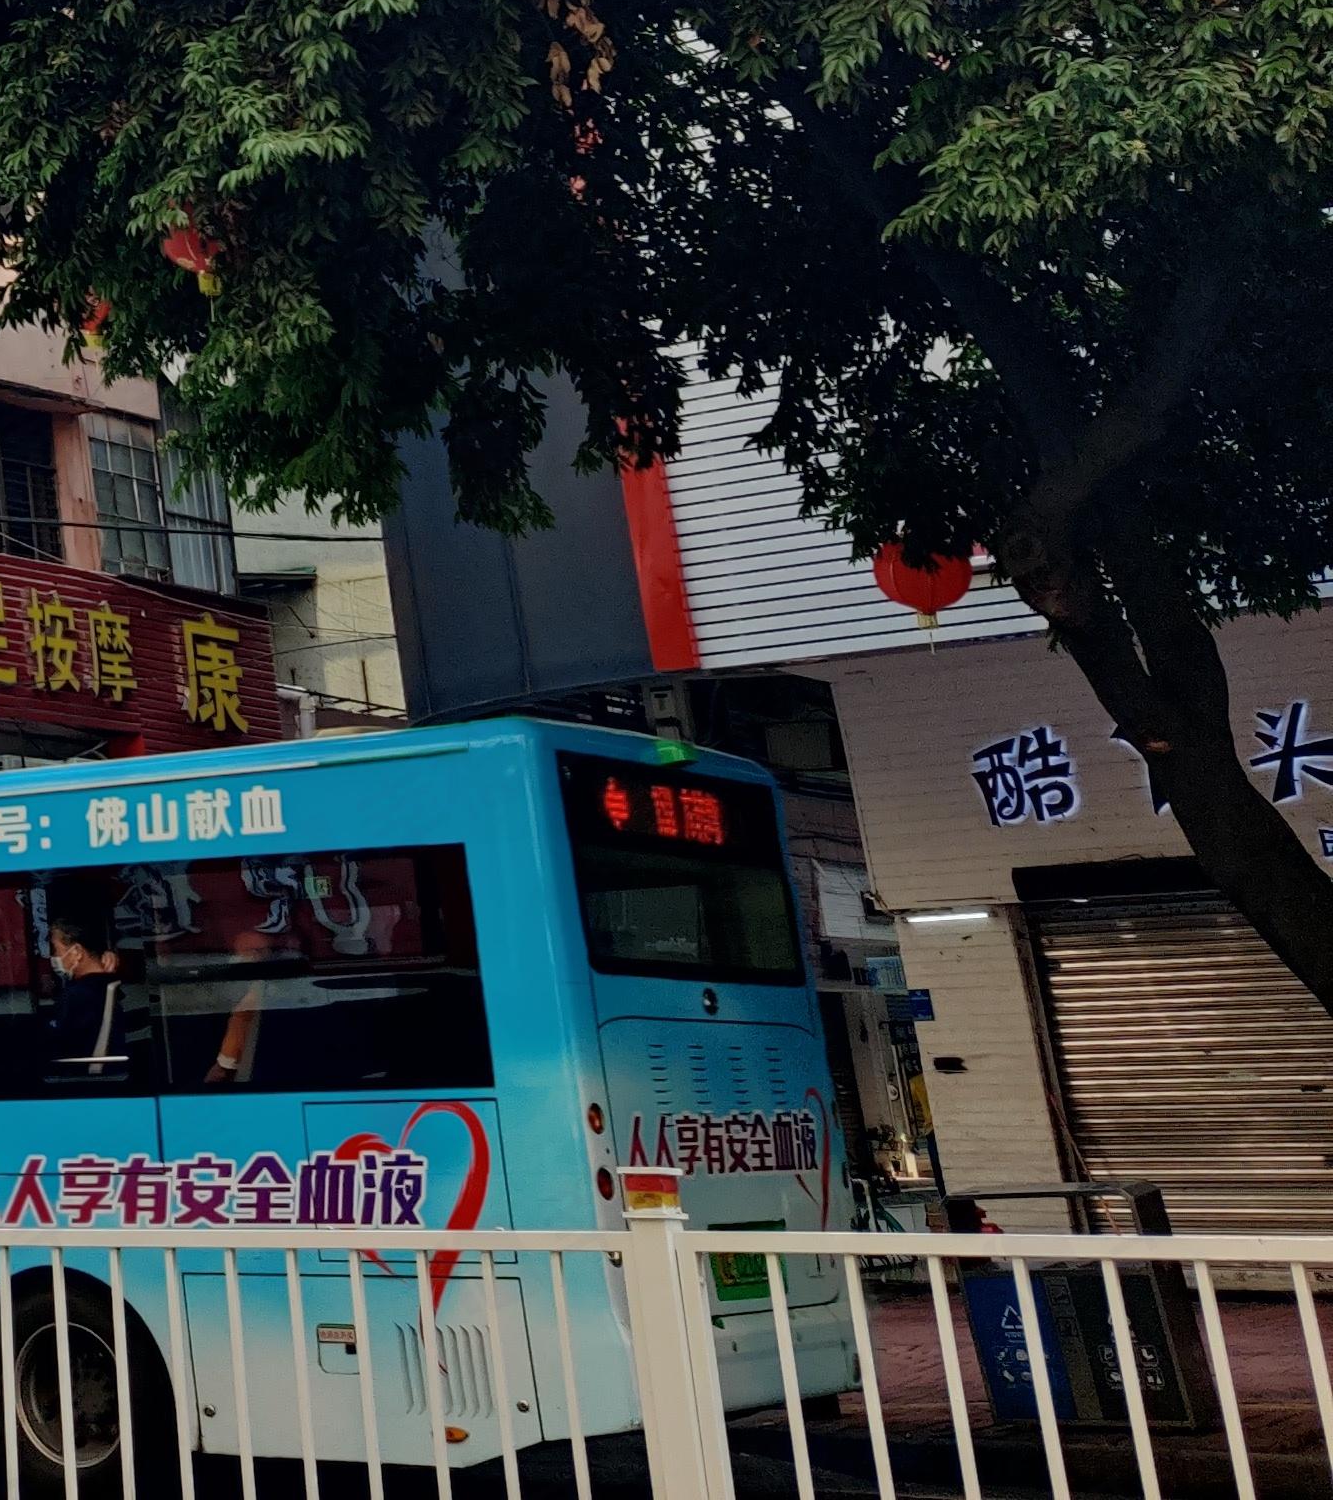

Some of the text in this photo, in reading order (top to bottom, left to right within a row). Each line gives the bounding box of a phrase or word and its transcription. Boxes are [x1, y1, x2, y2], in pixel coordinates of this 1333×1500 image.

[181, 611, 250, 734] 康
[85, 784, 286, 848] 佛山献血
[628, 1110, 820, 1176] 人人享有安全血液
